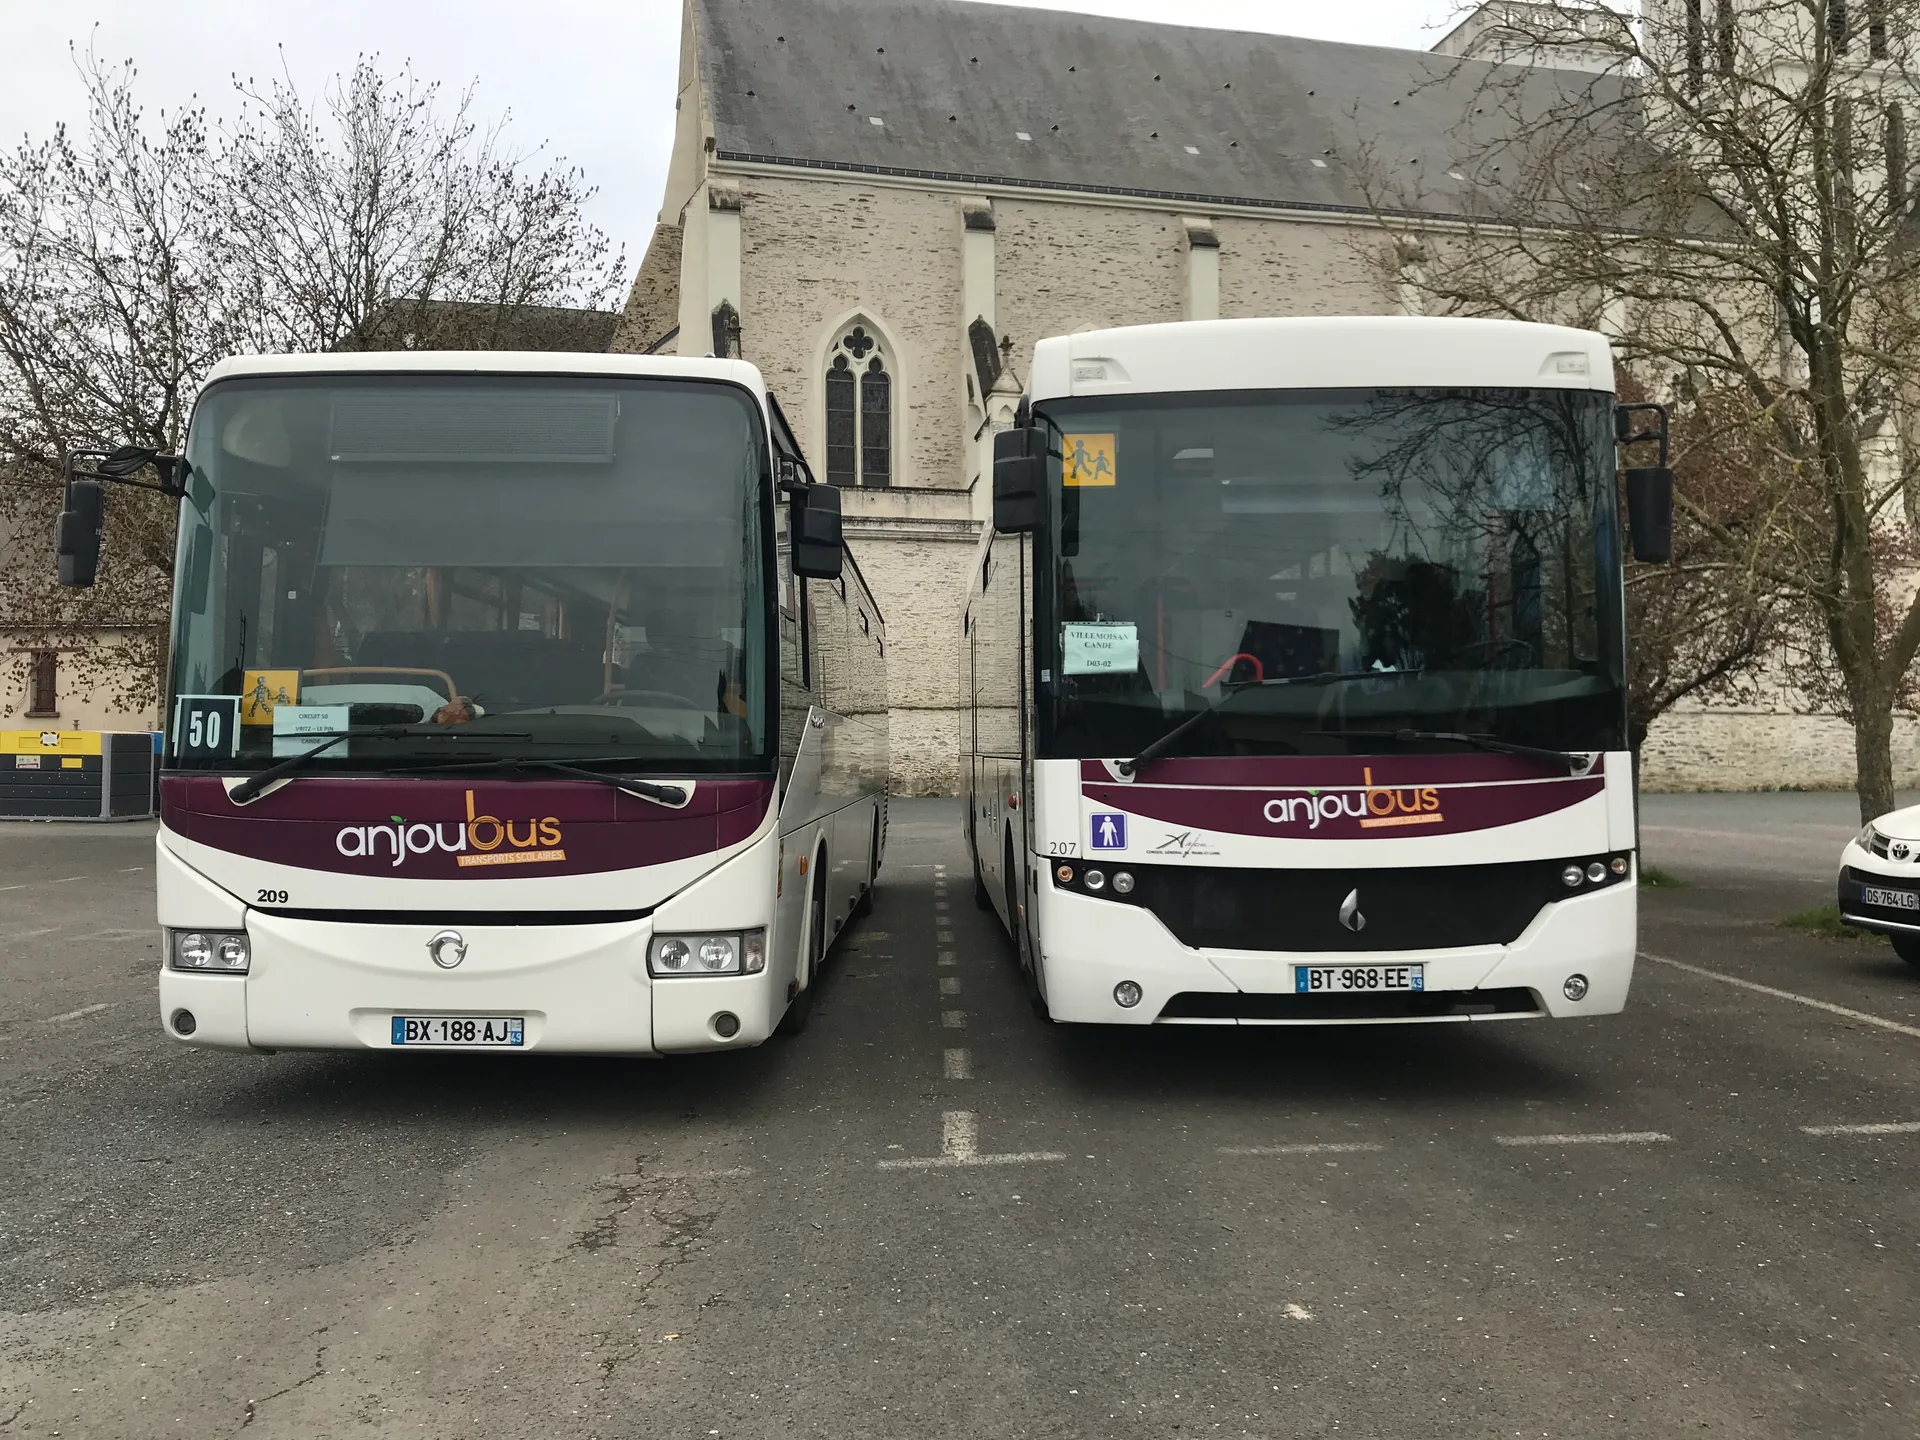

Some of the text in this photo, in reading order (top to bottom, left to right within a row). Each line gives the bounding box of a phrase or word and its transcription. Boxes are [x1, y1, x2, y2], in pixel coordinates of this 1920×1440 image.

[1071, 632, 1128, 640] VILLEMOISAN
[1084, 641, 1114, 649] CANDE
[1086, 659, 1112, 667] D03-02
[189, 710, 221, 749] 50
[1263, 767, 1439, 829] anjoubus
[336, 789, 562, 867] anjoubus
[1050, 842, 1077, 855] 207
[460, 850, 562, 865] TRANSPORTS SCOLAIRES
[257, 889, 289, 903] 209
[1867, 889, 1913, 907] DS-764-LG
[1310, 968, 1409, 989] BT-968-EE
[406, 1020, 508, 1041] BX-188-AJ
